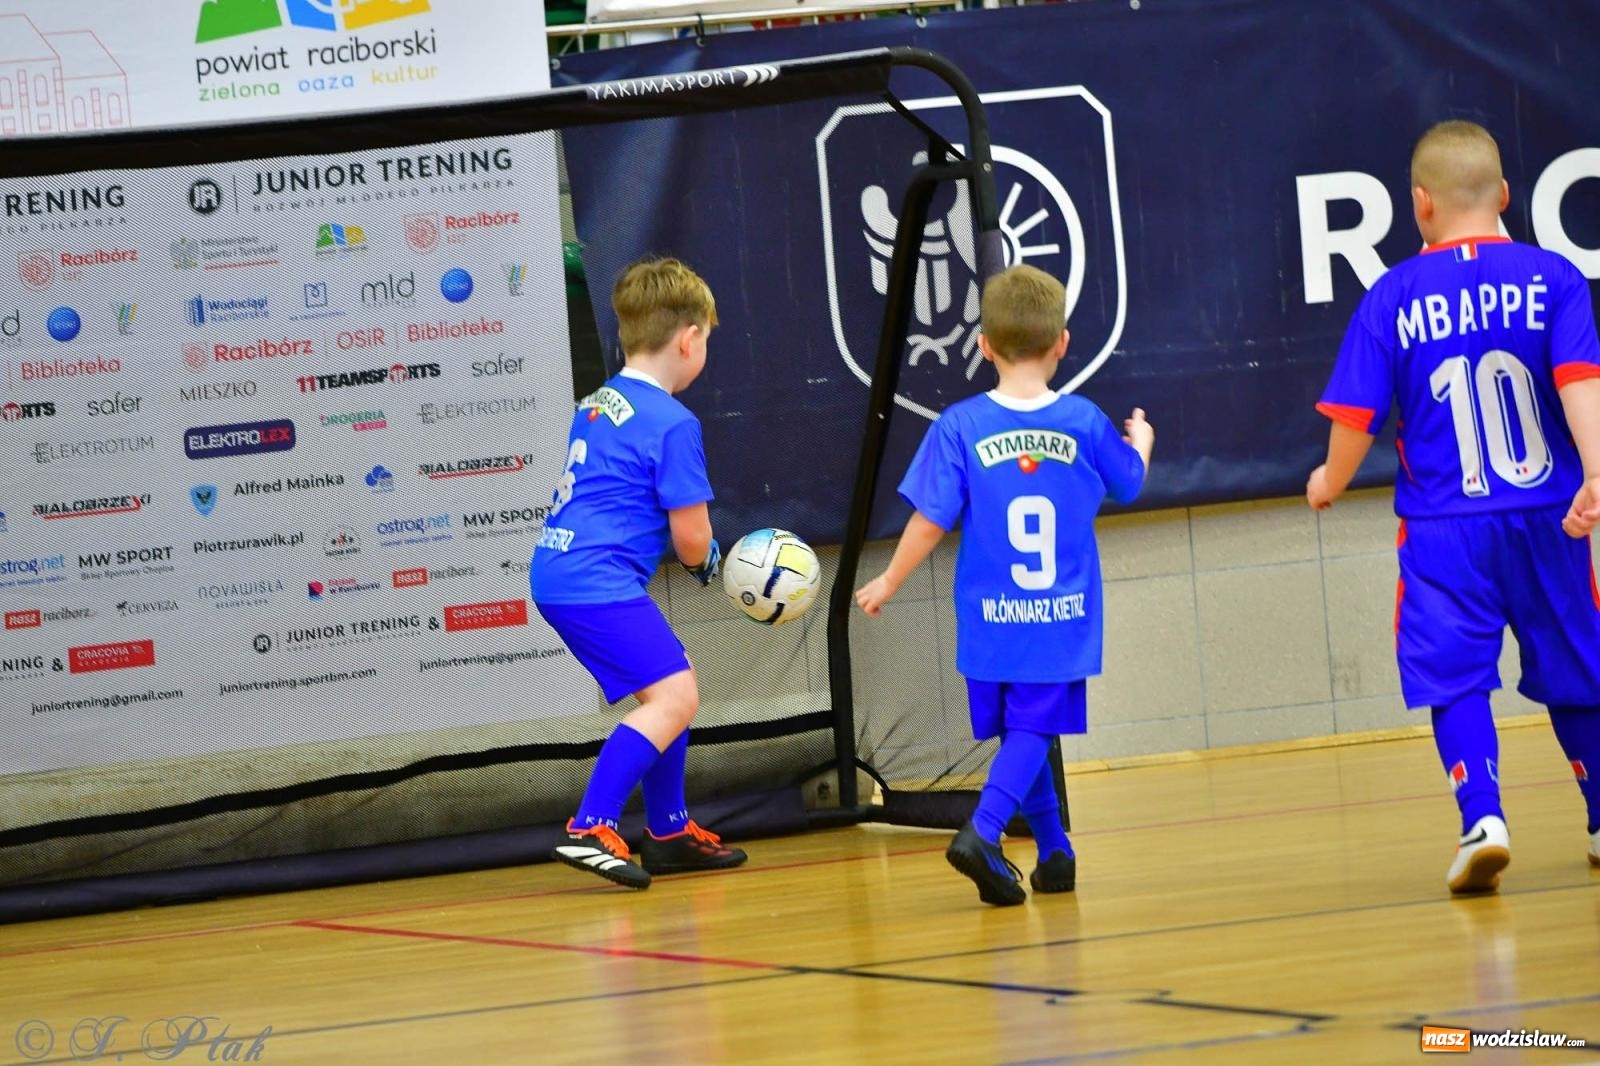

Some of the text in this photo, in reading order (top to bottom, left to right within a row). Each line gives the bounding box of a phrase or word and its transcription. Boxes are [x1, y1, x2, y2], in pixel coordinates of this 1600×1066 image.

[195, 29, 438, 83] powiat raciborski
[199, 64, 439, 102] zielona oaza kultur
[588, 69, 736, 101] YAKIMASPORT
[252, 158, 367, 197] JUNIOR
[377, 148, 513, 183] TRENING
[444, 210, 520, 230] Racibórz
[1295, 147, 1600, 305] RC
[60, 247, 138, 268] Racibórz
[361, 270, 416, 304] mld
[1396, 274, 1549, 350] MBAPPÉ
[213, 316, 505, 362] Racibórz OSiR Biblioteka
[21, 355, 121, 381] Biblioteka
[471, 353, 525, 378] safer
[87, 391, 143, 417] safer
[179, 379, 257, 402] MIESZKO
[1429, 349, 1553, 498] 10
[188, 426, 291, 451] ELEKTROLEX
[981, 433, 1074, 460] TYMBARK
[233, 473, 345, 497] Alfred Mainka
[463, 510, 496, 528] MW
[1007, 494, 1057, 591] 9
[78, 545, 174, 570] MW SPORT
[981, 592, 1086, 624] WŁÓKNIARZ KIETRZ
[286, 623, 345, 644] JUNIOR
[351, 614, 421, 636] TRENING
[428, 616, 440, 631] &
[51, 657, 64, 672] &
[76, 645, 130, 660] CRACOVIA
[418, 646, 566, 672] juniortrening@gmail.com
[218, 667, 378, 696] juniortrening.sportbm.com
[31, 688, 184, 716] juniortrening@gmail.com
